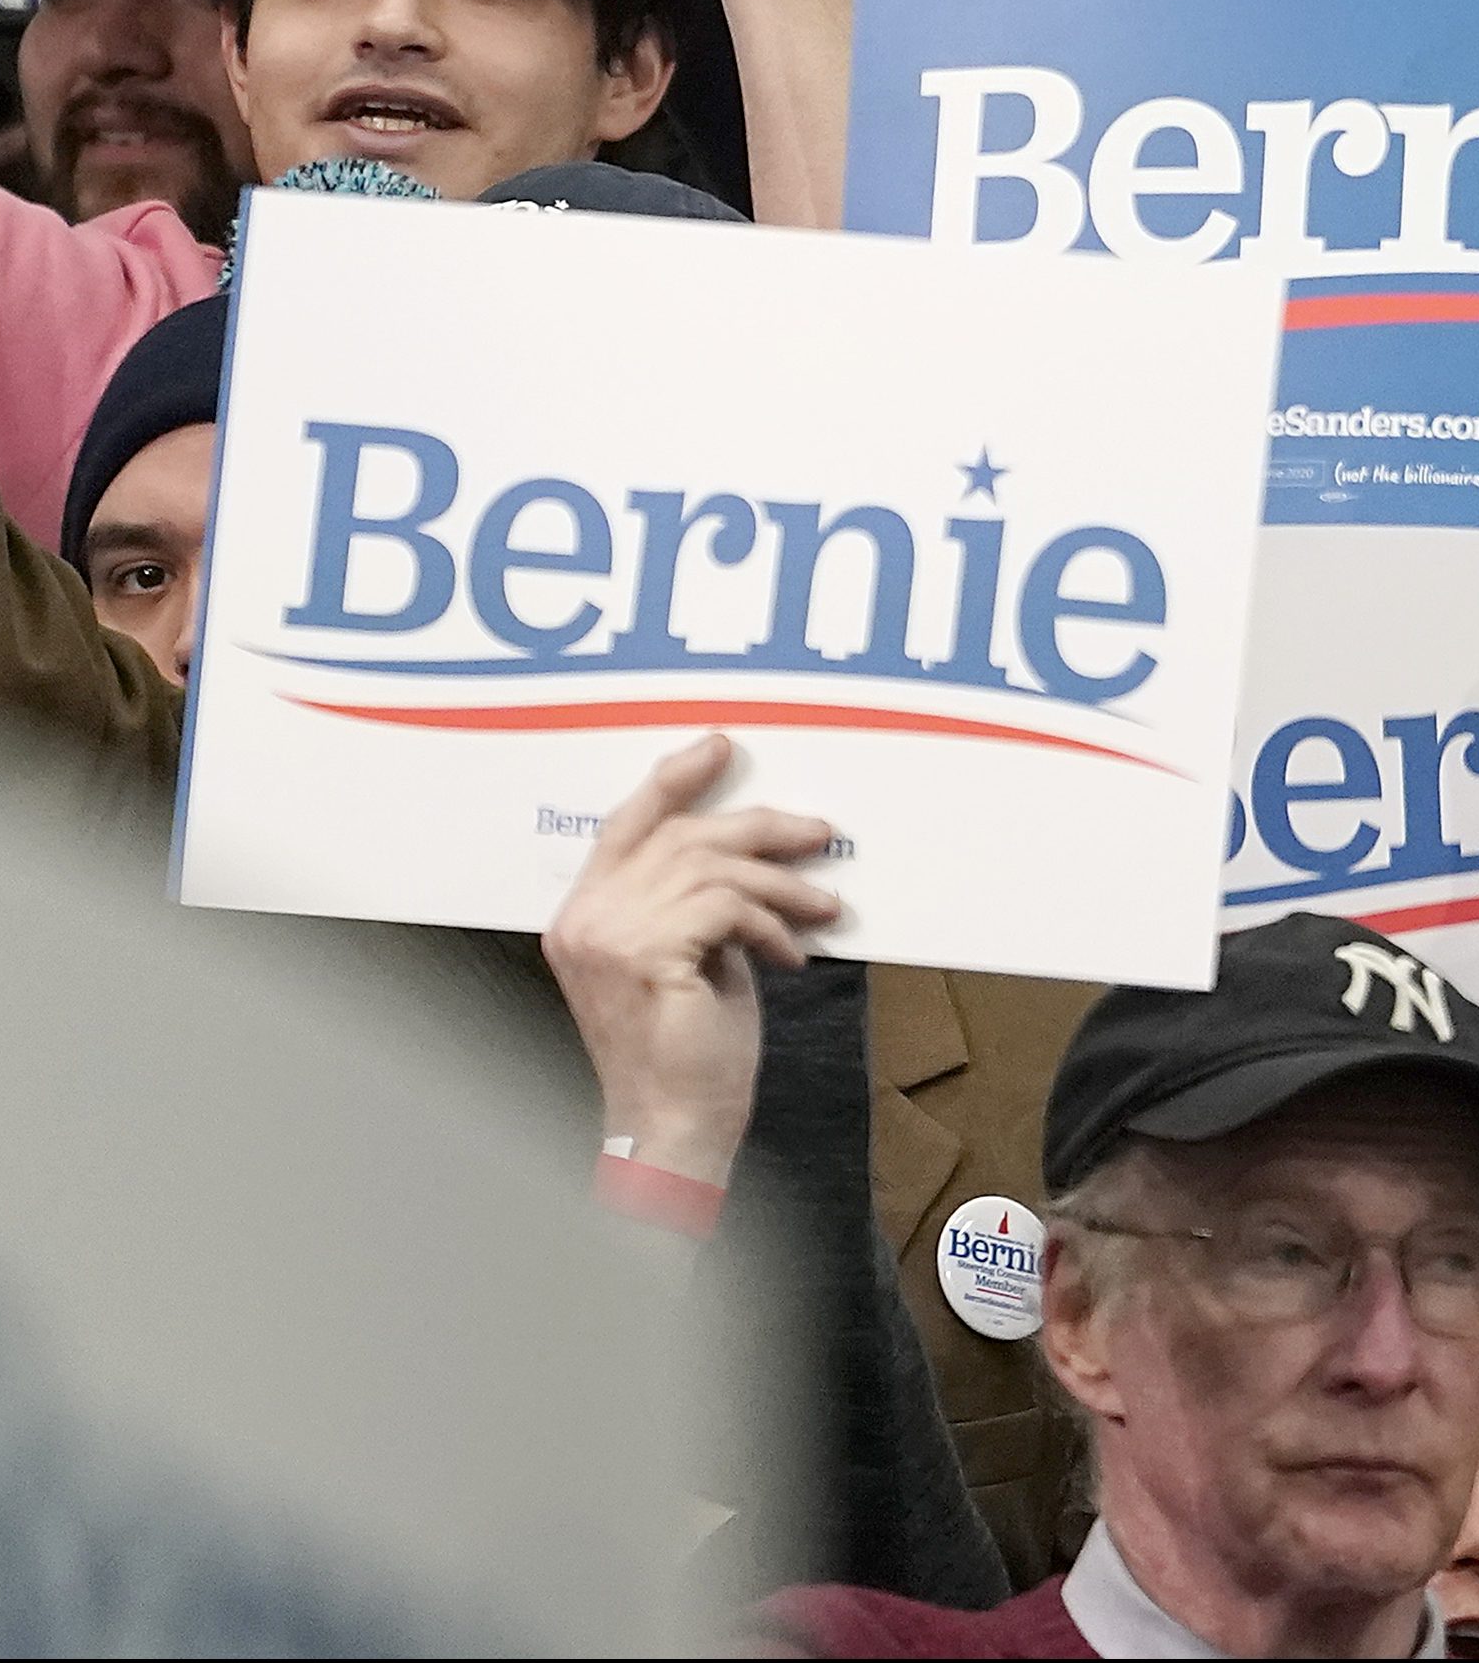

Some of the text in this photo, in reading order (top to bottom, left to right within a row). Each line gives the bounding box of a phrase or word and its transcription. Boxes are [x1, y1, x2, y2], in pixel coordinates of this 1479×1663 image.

[1334, 460, 1367, 487] (not
[1372, 464, 1401, 485] the
[283, 417, 1168, 706] Bernie
[948, 1228, 1039, 1276] Berni
